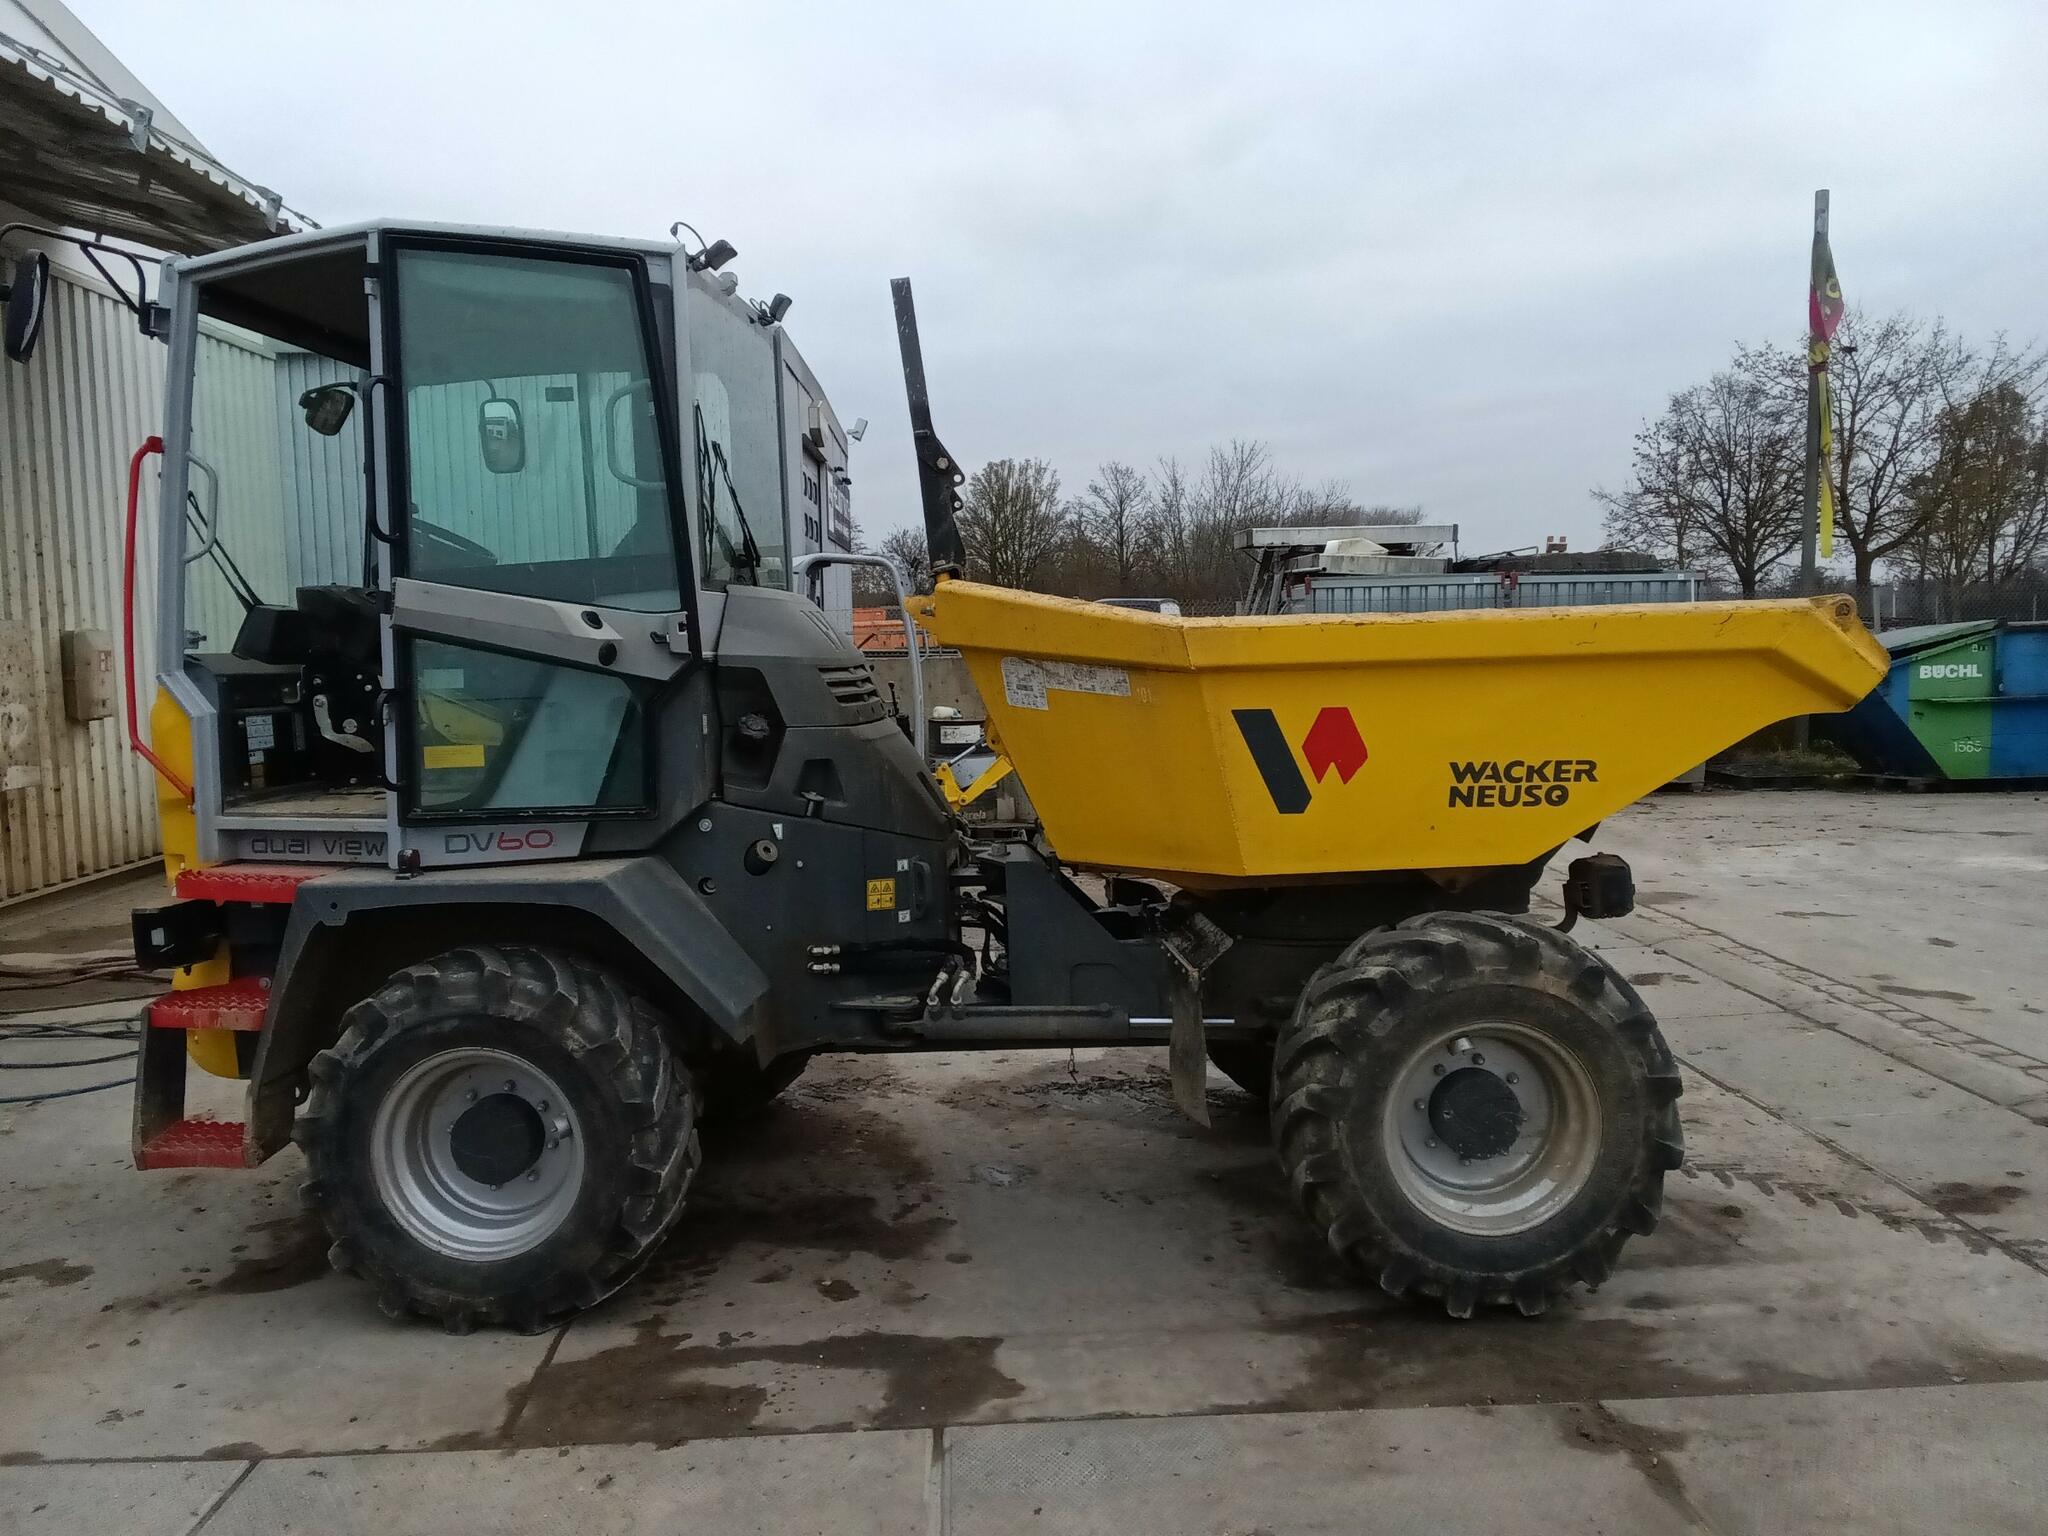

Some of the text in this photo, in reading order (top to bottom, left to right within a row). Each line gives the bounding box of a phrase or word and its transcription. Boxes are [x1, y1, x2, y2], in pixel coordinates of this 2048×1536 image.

[1449, 759, 1599, 784] WACKER
[251, 838, 386, 857] dual view
[444, 829, 554, 854] DV60
